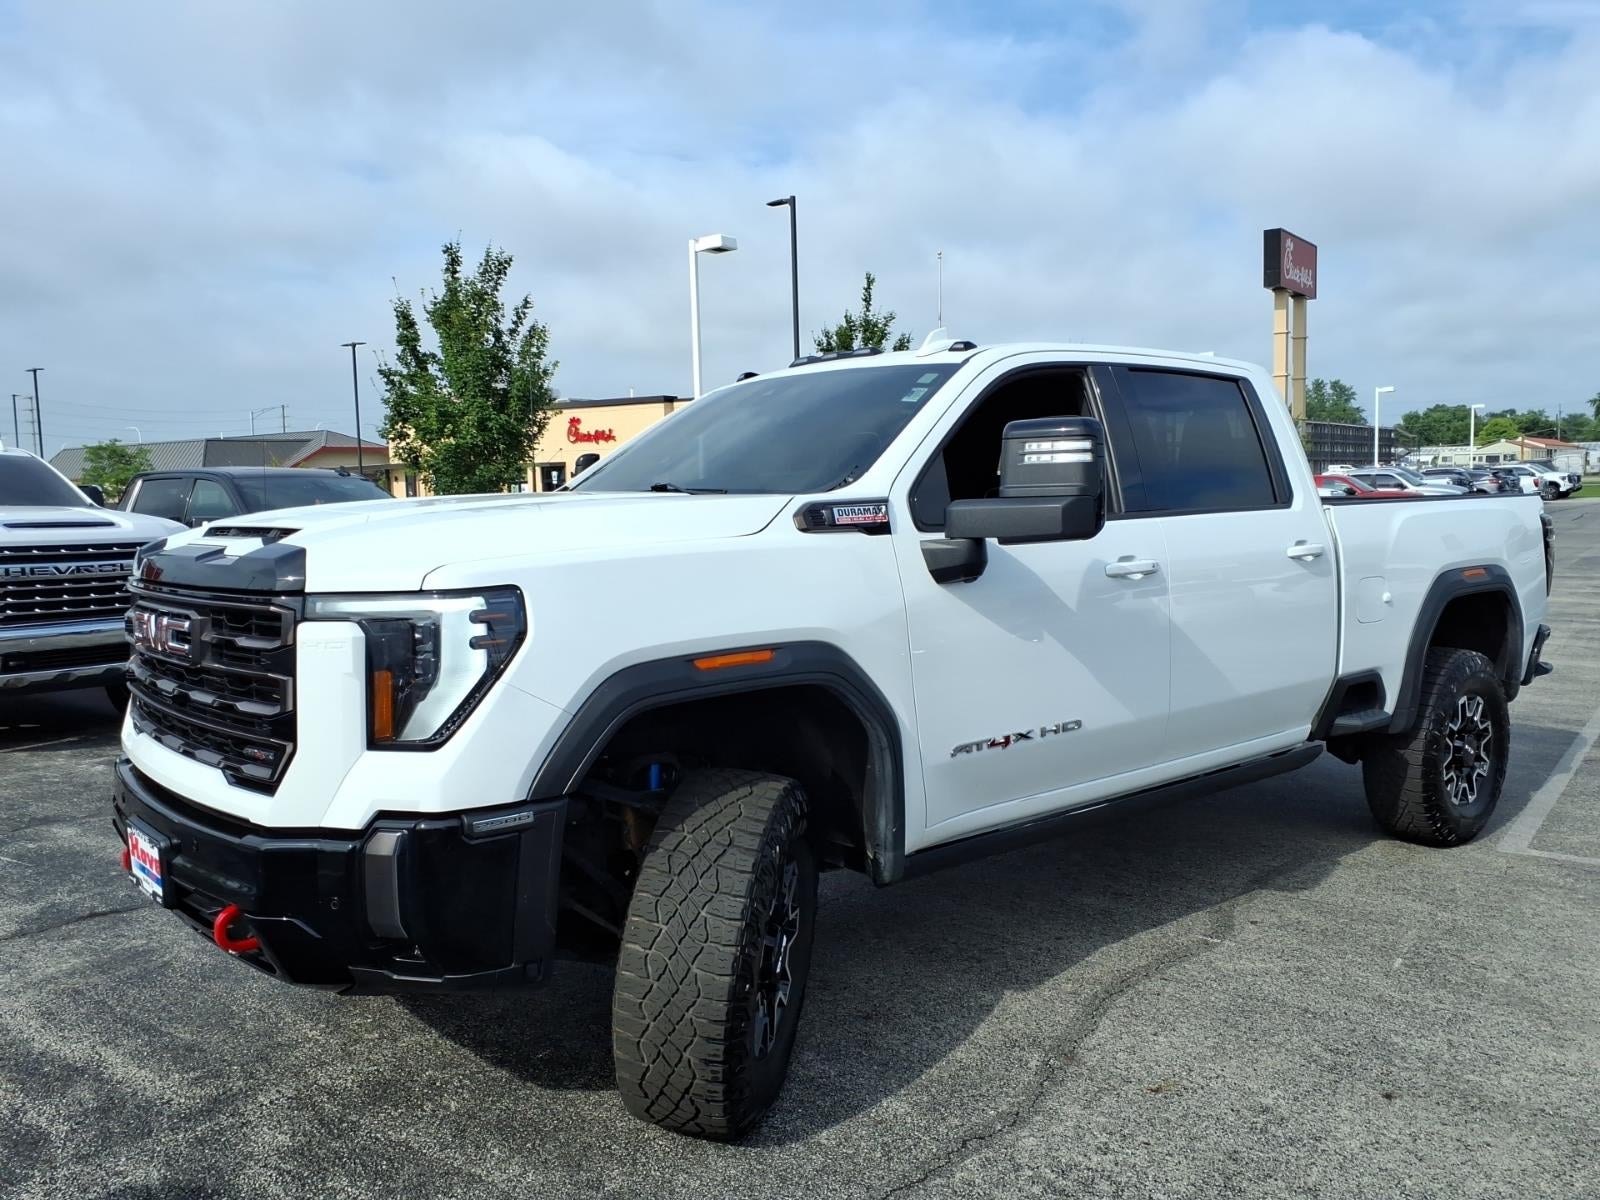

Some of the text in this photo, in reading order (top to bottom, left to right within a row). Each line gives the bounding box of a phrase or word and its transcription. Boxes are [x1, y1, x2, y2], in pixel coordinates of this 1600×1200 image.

[837, 504, 886, 517] DURAMAX
[0, 562, 132, 577] HEVROL
[134, 611, 192, 658] GMC
[950, 719, 1083, 758] AT4X HD
